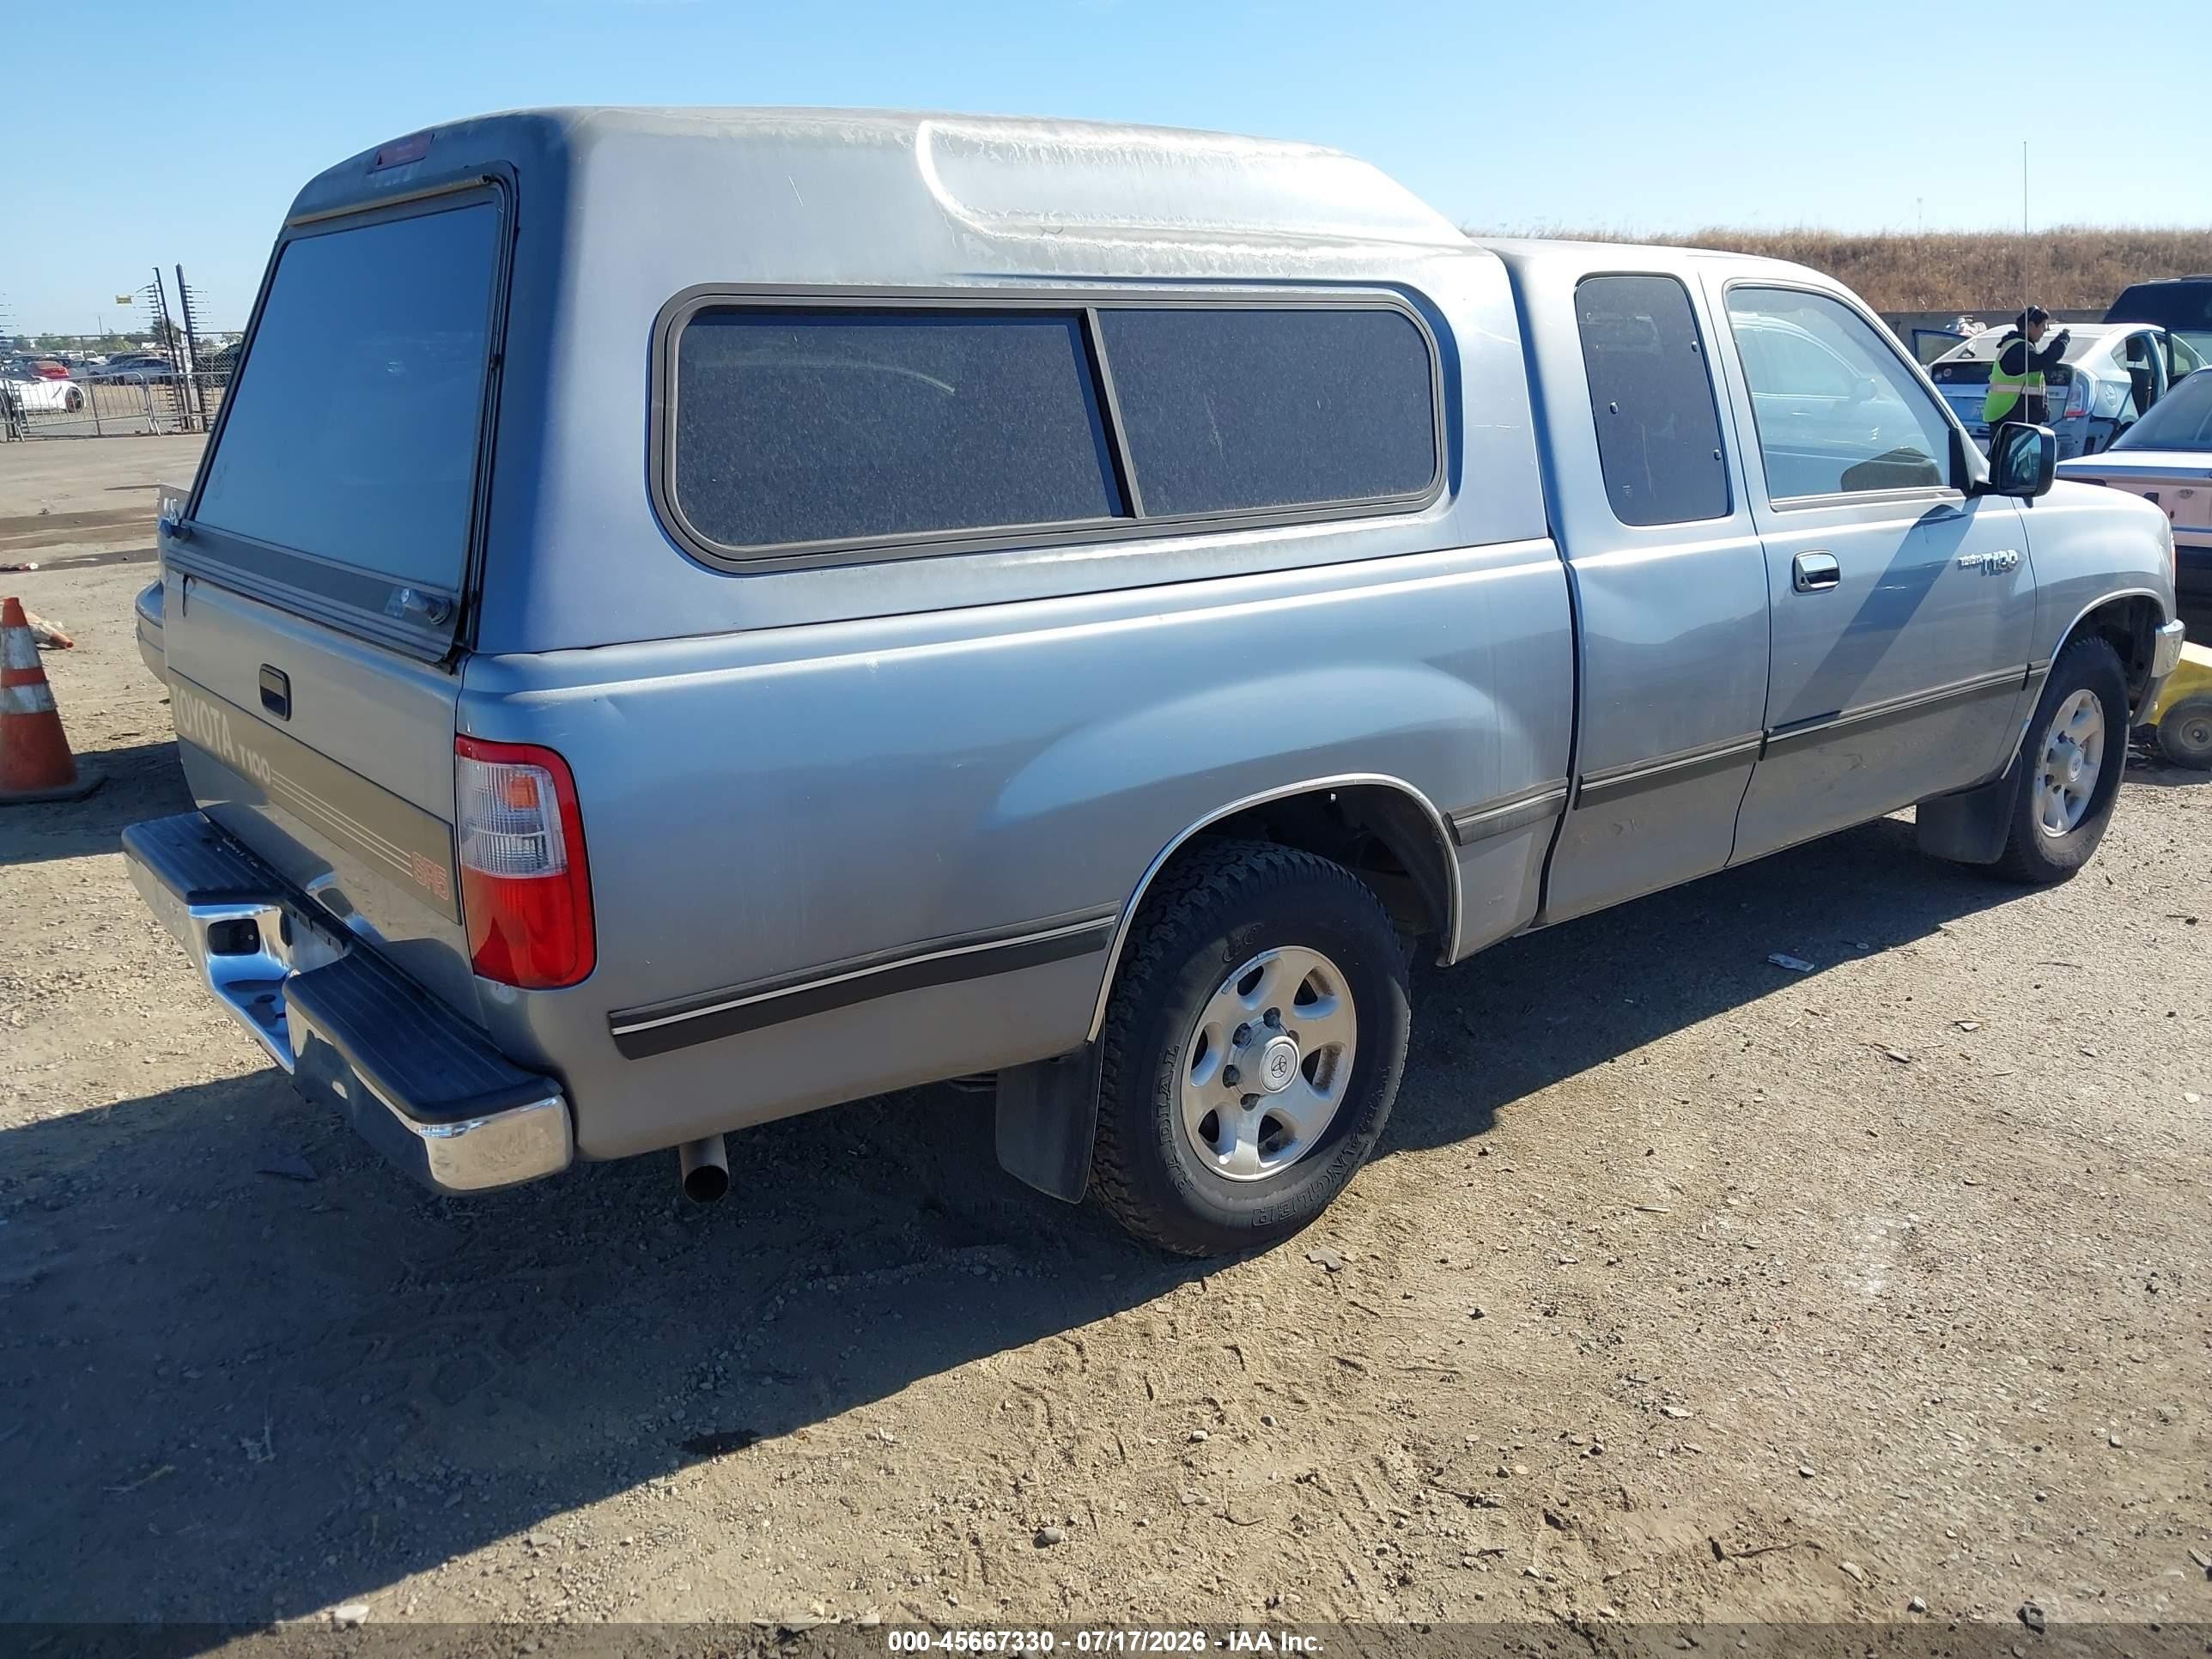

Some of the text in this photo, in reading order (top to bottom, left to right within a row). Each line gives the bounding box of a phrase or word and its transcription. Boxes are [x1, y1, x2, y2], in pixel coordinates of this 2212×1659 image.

[1981, 550, 2018, 572] T100
[170, 684, 271, 786] TOYOTA T100
[412, 851, 449, 900] SR5
